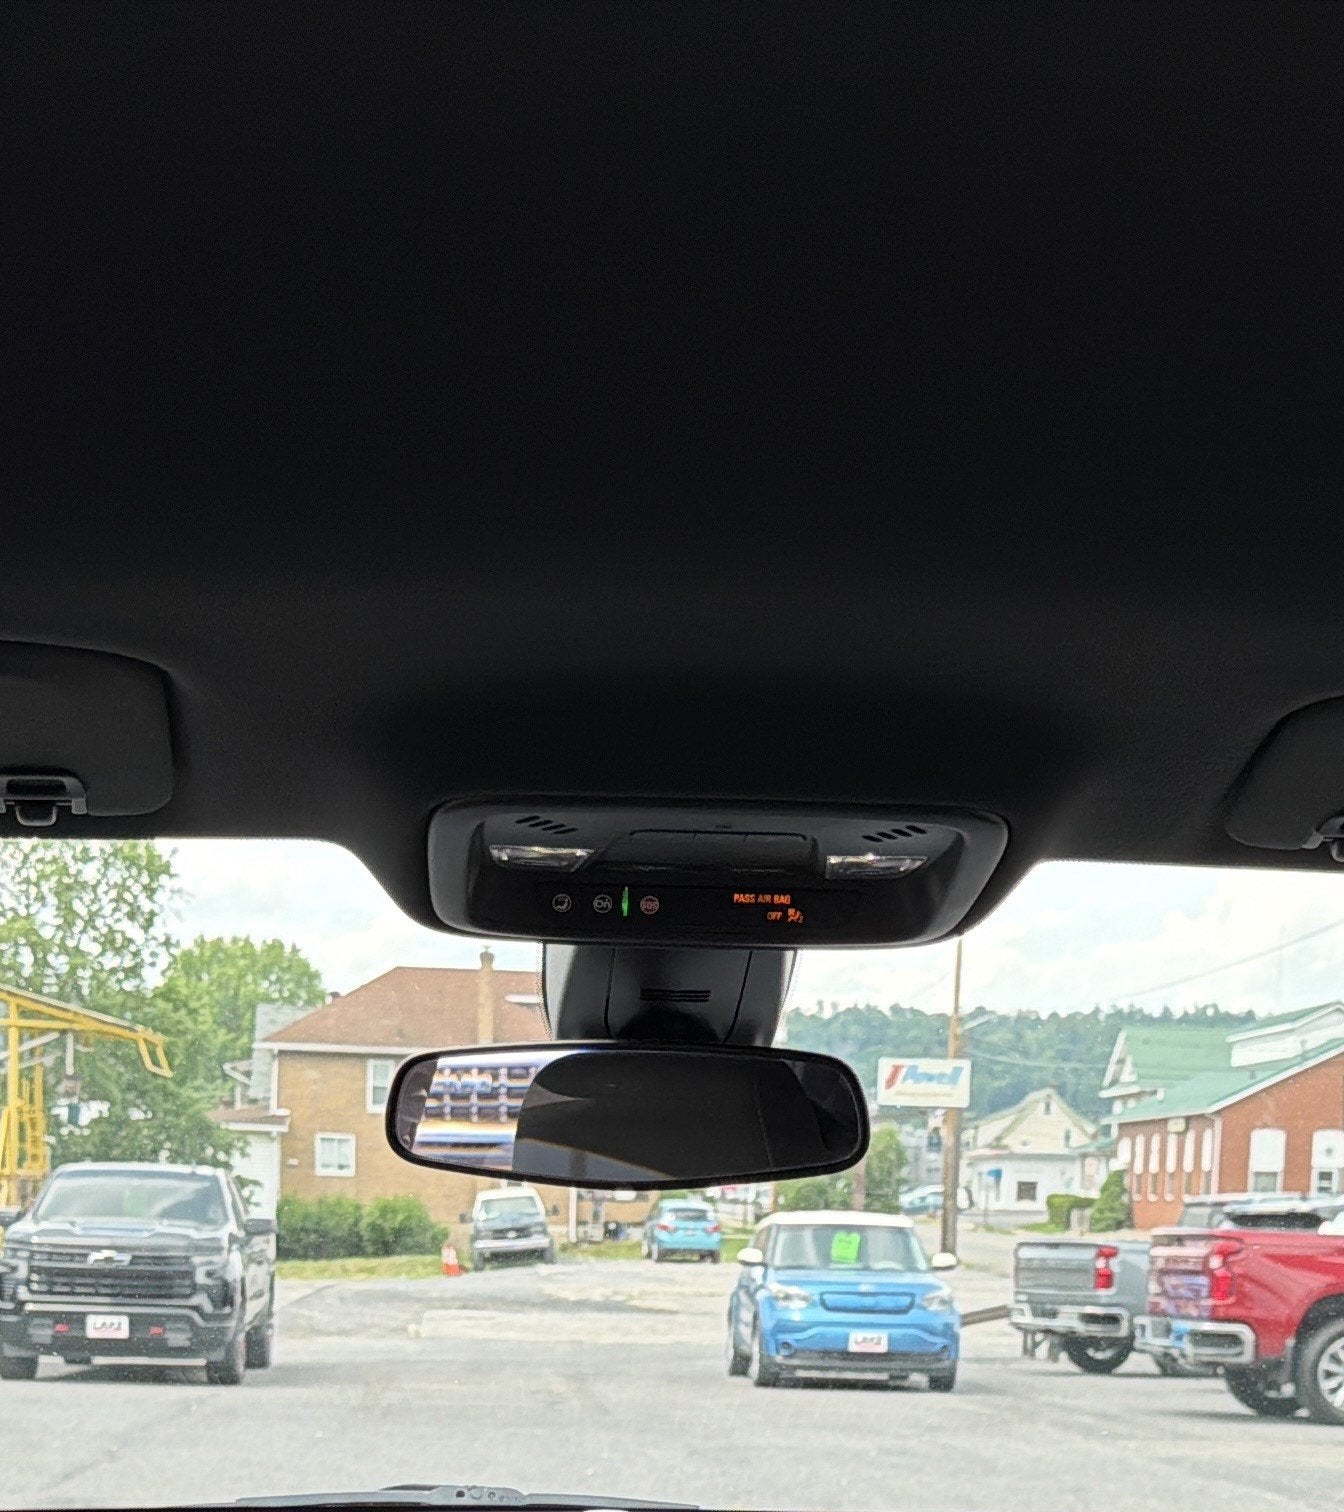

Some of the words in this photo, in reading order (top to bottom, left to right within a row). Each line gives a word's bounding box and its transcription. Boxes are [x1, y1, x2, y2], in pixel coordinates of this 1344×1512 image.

[733, 893, 756, 904] PASS
[773, 895, 791, 905] BAG
[767, 911, 782, 921] OFF
